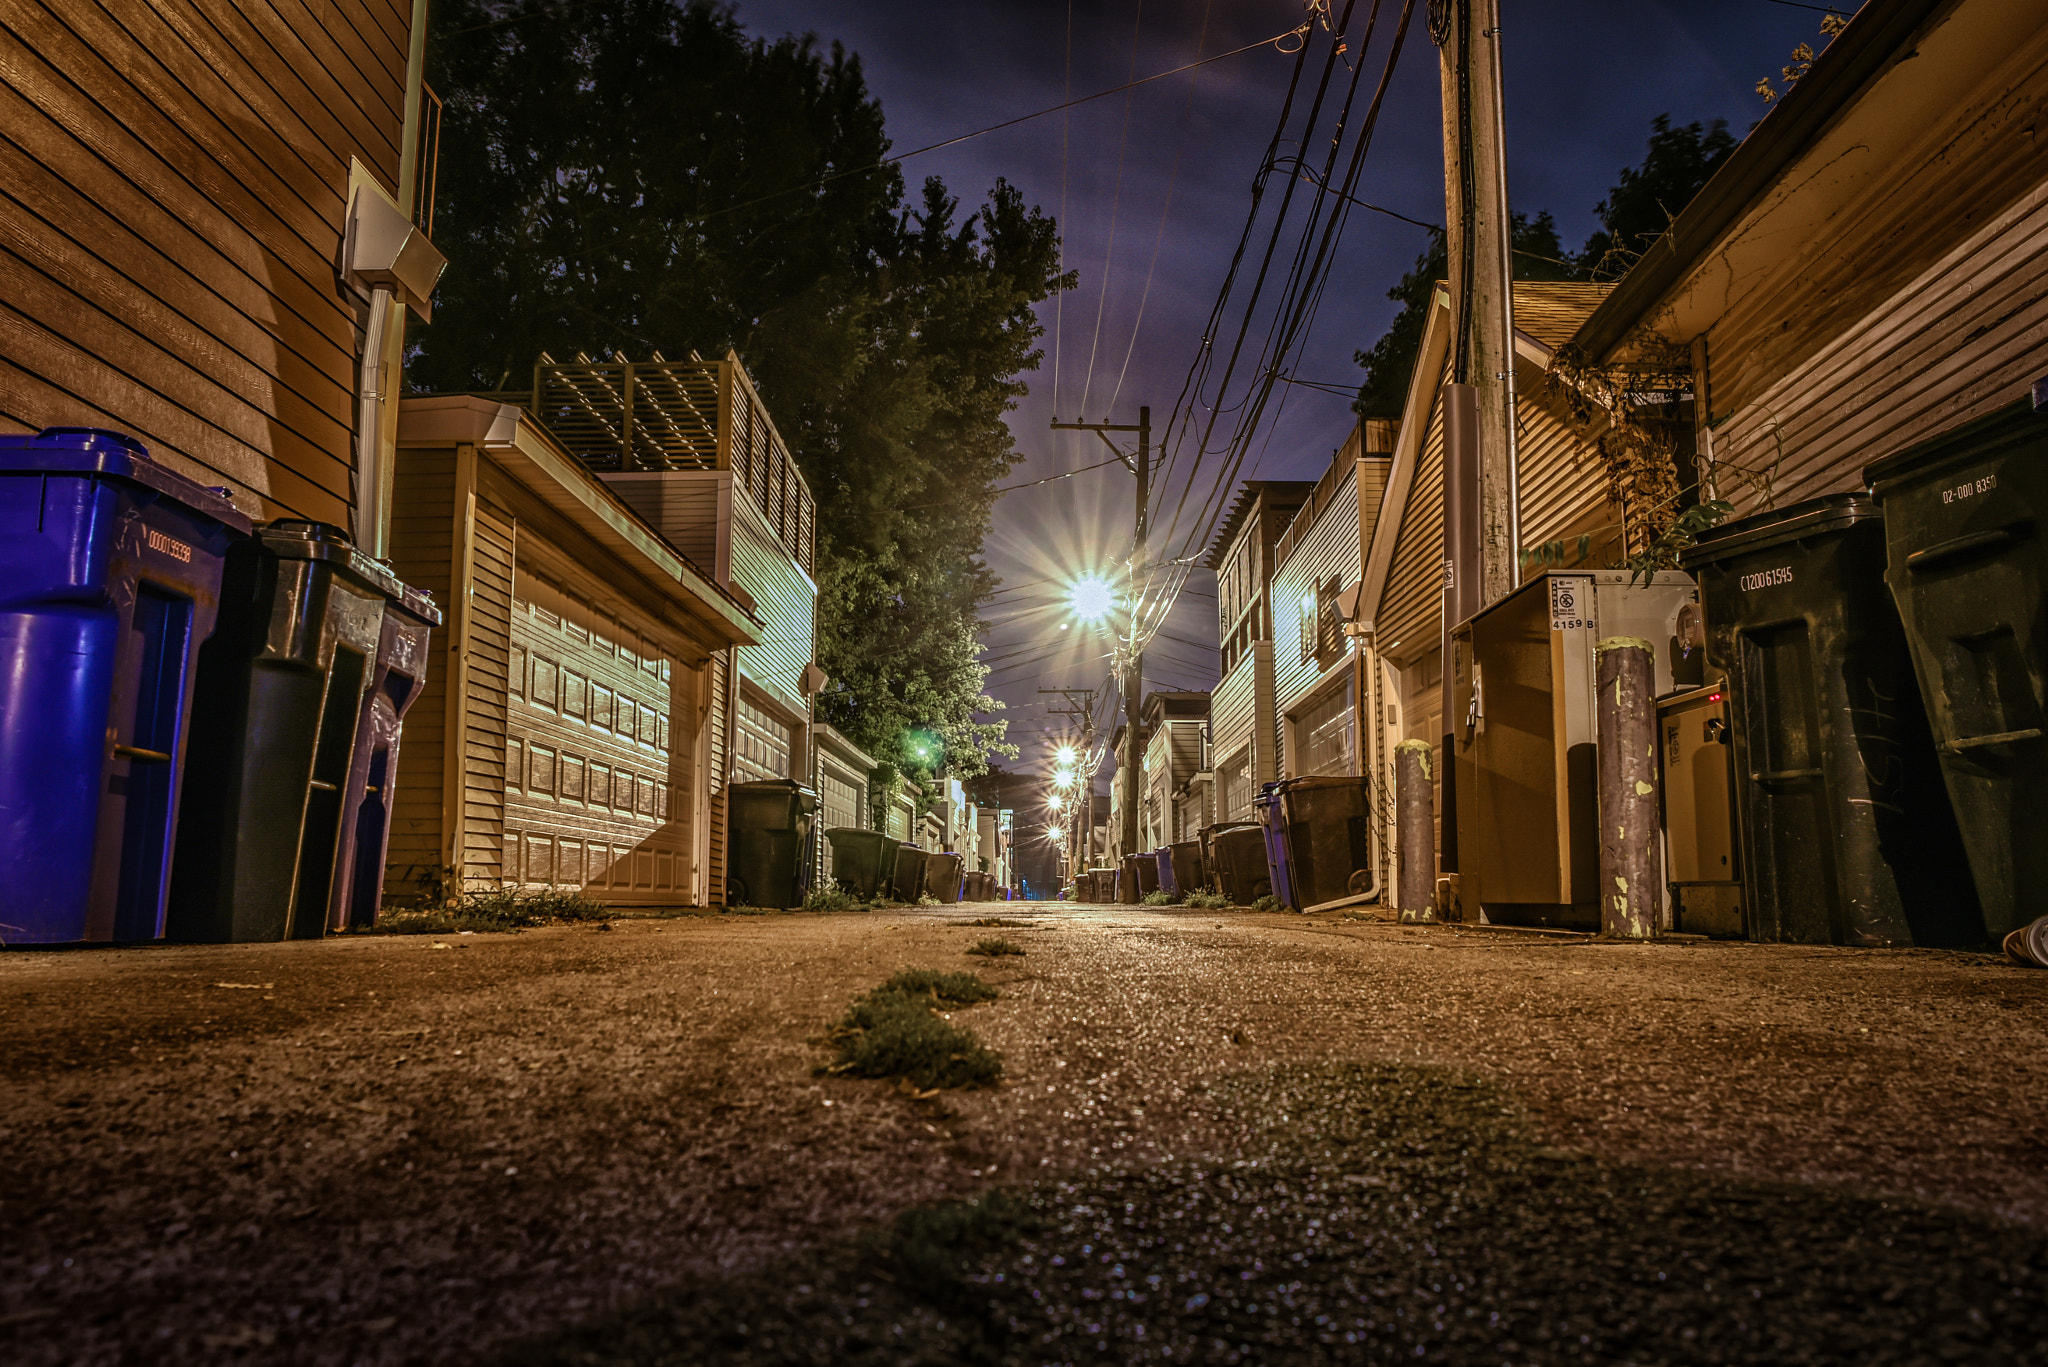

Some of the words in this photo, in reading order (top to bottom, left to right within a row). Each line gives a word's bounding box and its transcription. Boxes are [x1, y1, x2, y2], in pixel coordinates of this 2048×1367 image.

[1943, 482, 1973, 504] 02-000
[1976, 474, 1997, 493] 8350
[149, 530, 191, 563] 0000199398
[1553, 619, 1582, 629] 4159
[1587, 620, 1593, 629] B
